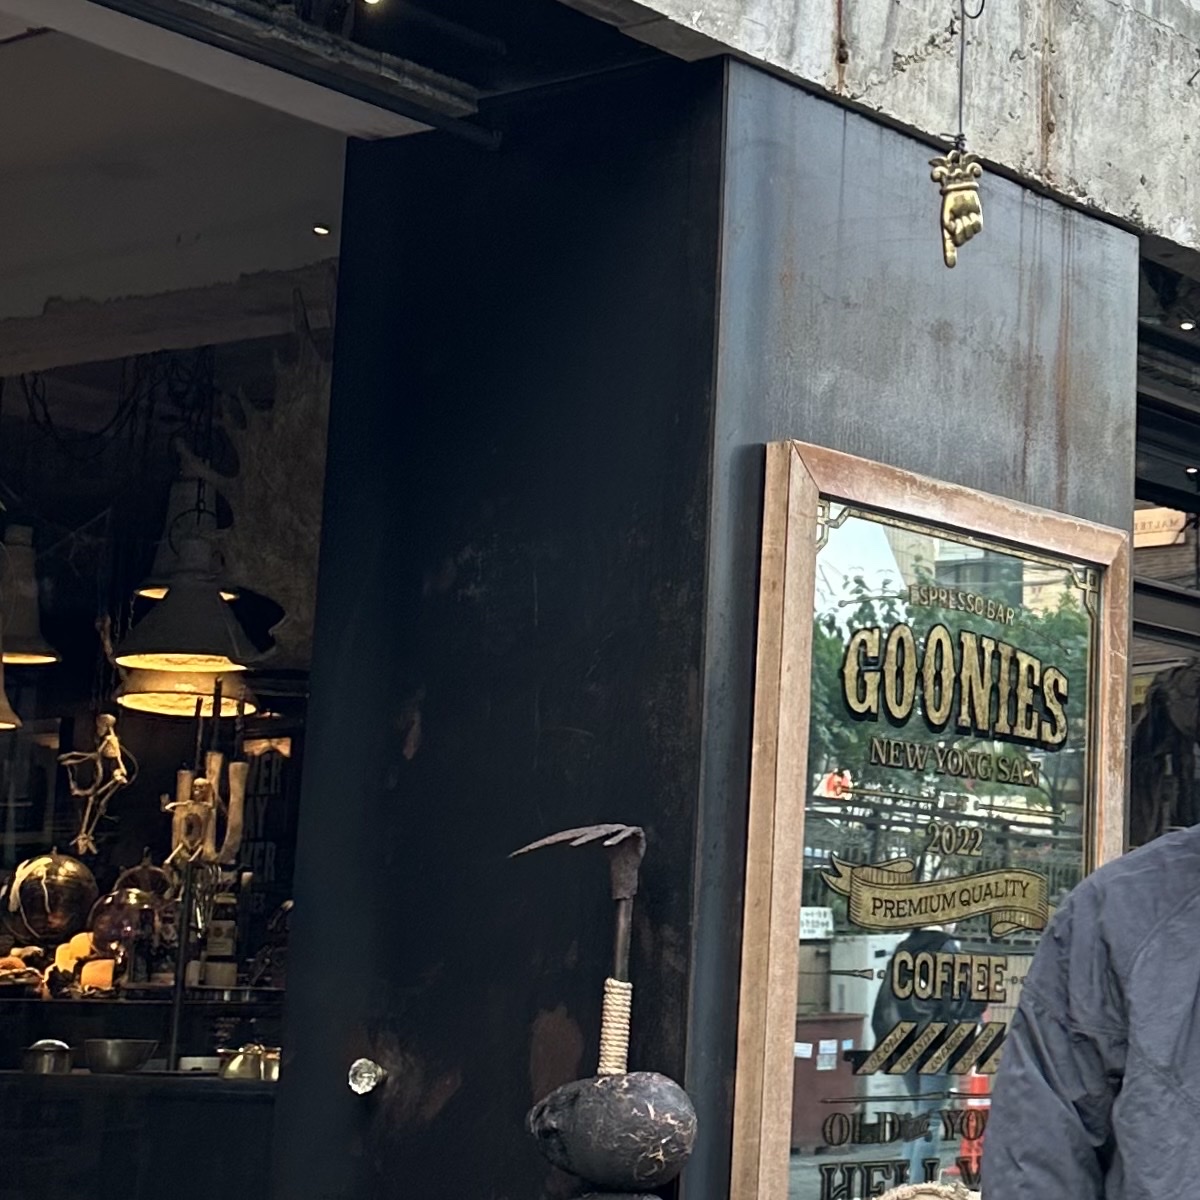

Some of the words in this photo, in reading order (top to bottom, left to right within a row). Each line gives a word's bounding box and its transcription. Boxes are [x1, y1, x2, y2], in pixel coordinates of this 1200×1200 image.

[909, 583, 984, 616] ESPRESSO
[987, 600, 1015, 626] BAR
[842, 622, 1069, 750] GOONIES
[870, 736, 930, 771] NEW
[934, 746, 993, 782] YONG
[997, 757, 1041, 787] SAN
[925, 821, 984, 856] 2022
[871, 891, 957, 918] PREMIUM
[960, 879, 1030, 906] QUALITY
[892, 950, 1008, 1002] COFFEE
[822, 1111, 901, 1146] OLD
[940, 1109, 987, 1141] YO
